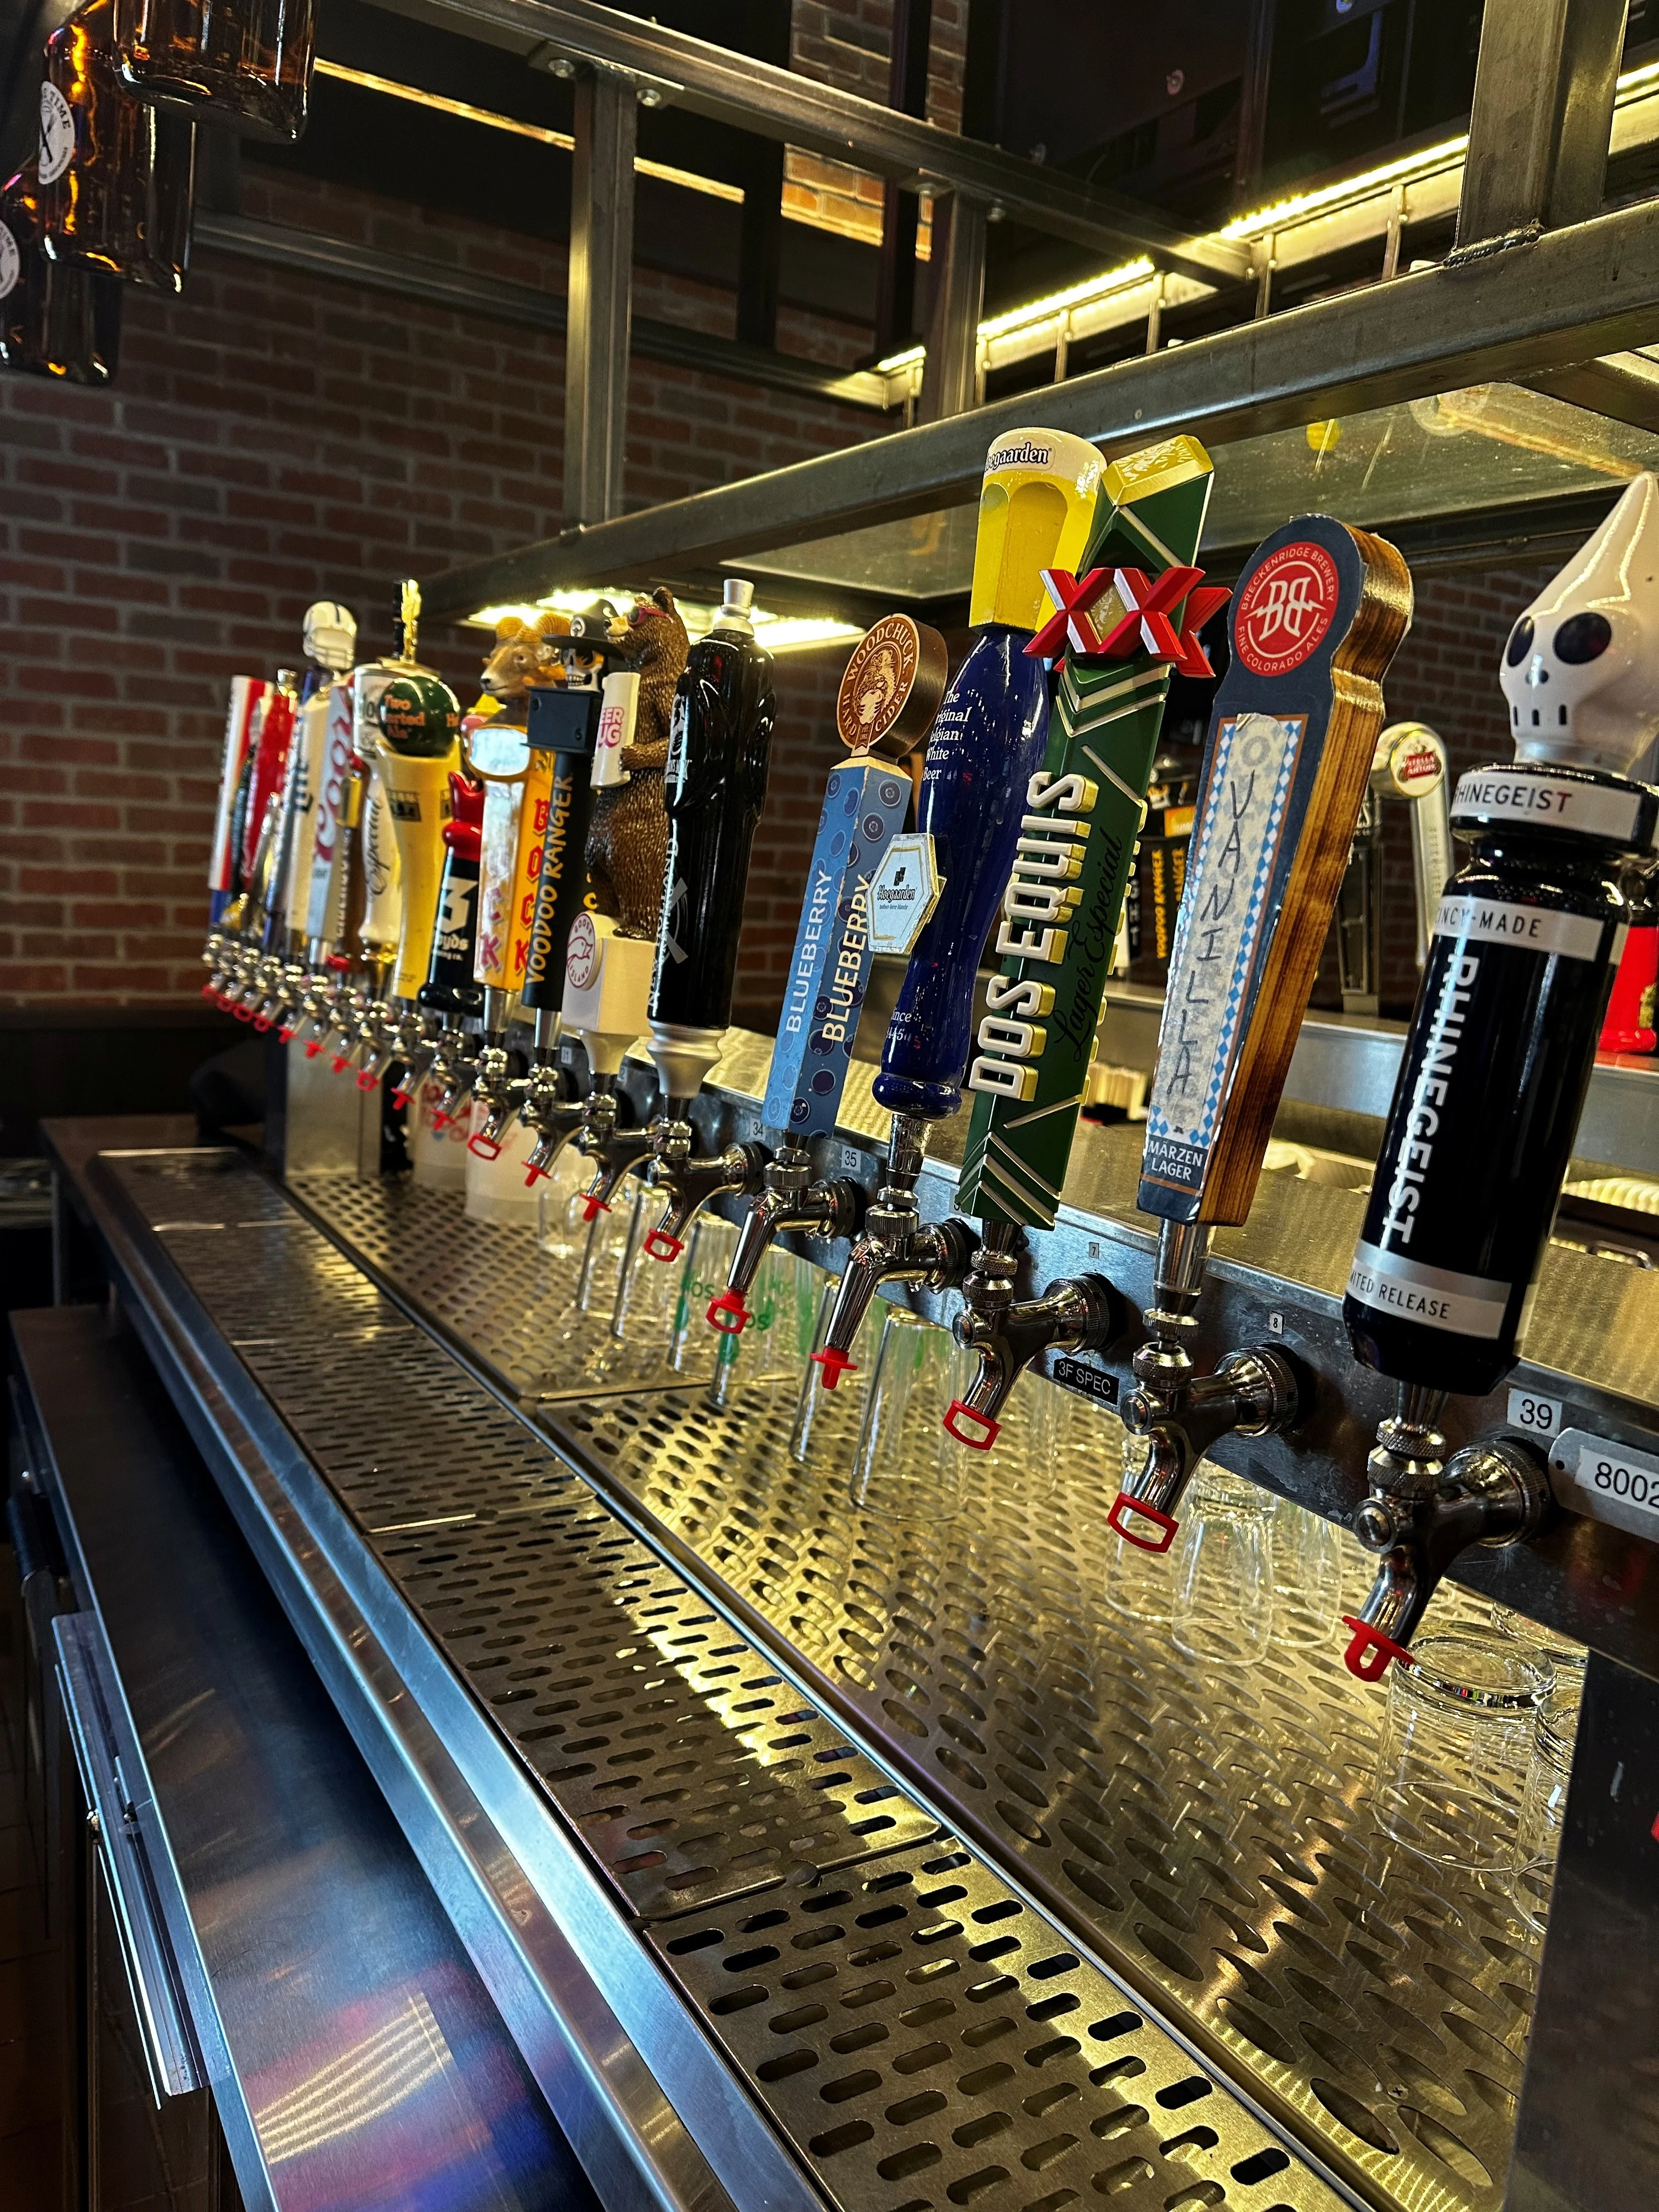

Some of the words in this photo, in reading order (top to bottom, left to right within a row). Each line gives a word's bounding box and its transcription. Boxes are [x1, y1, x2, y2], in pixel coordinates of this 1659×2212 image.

[1240, 547, 1310, 611] BRECKENRIDGE
[1311, 551, 1334, 602] BREWERY
[847, 623, 913, 682] WOODCHUCK
[1238, 625, 1249, 654] FINE
[1246, 651, 1302, 672] COLORADO
[1306, 617, 1328, 651] ALES
[385, 693, 410, 710] Two
[843, 692, 856, 736] HARD
[875, 681, 909, 732] CIDER
[943, 690, 960, 704] The
[935, 706, 972, 726] riginal
[597, 723, 621, 747] UG
[930, 726, 959, 745] elgian
[926, 746, 950, 761] White
[923, 767, 942, 781] Beer
[525, 884, 557, 985] VOODOO
[542, 775, 573, 879] RANGER
[996, 771, 1099, 964] EQUIS
[513, 797, 549, 978] BOCK
[877, 884, 916, 904] Hoegaarden
[1067, 826, 1122, 964] Especial
[574, 918, 592, 936] GOOSE
[1167, 770, 1255, 1094] VANILLA
[1435, 906, 1542, 939] INCY-MADE
[786, 870, 832, 1032] BLUEBERRY
[822, 874, 872, 1042] BLUEBERRY
[569, 965, 589, 982] ISLAND
[1053, 963, 1097, 1063] Lager
[969, 974, 1056, 1102] DOS
[1381, 955, 1480, 1244] RHINEGEIST
[752, 1122, 764, 1136] 34
[844, 1152, 856, 1166] 35
[1148, 1141, 1203, 1167] MÄRZEN
[1151, 1156, 1191, 1181] LAGER
[1091, 1245, 1097, 1256] 7
[1379, 1283, 1451, 1319] RELEASE
[1272, 1317, 1279, 1329] 8
[1058, 1361, 1073, 1377] 3F
[1076, 1368, 1111, 1395] SPEC
[1520, 1398, 1553, 1430] 39
